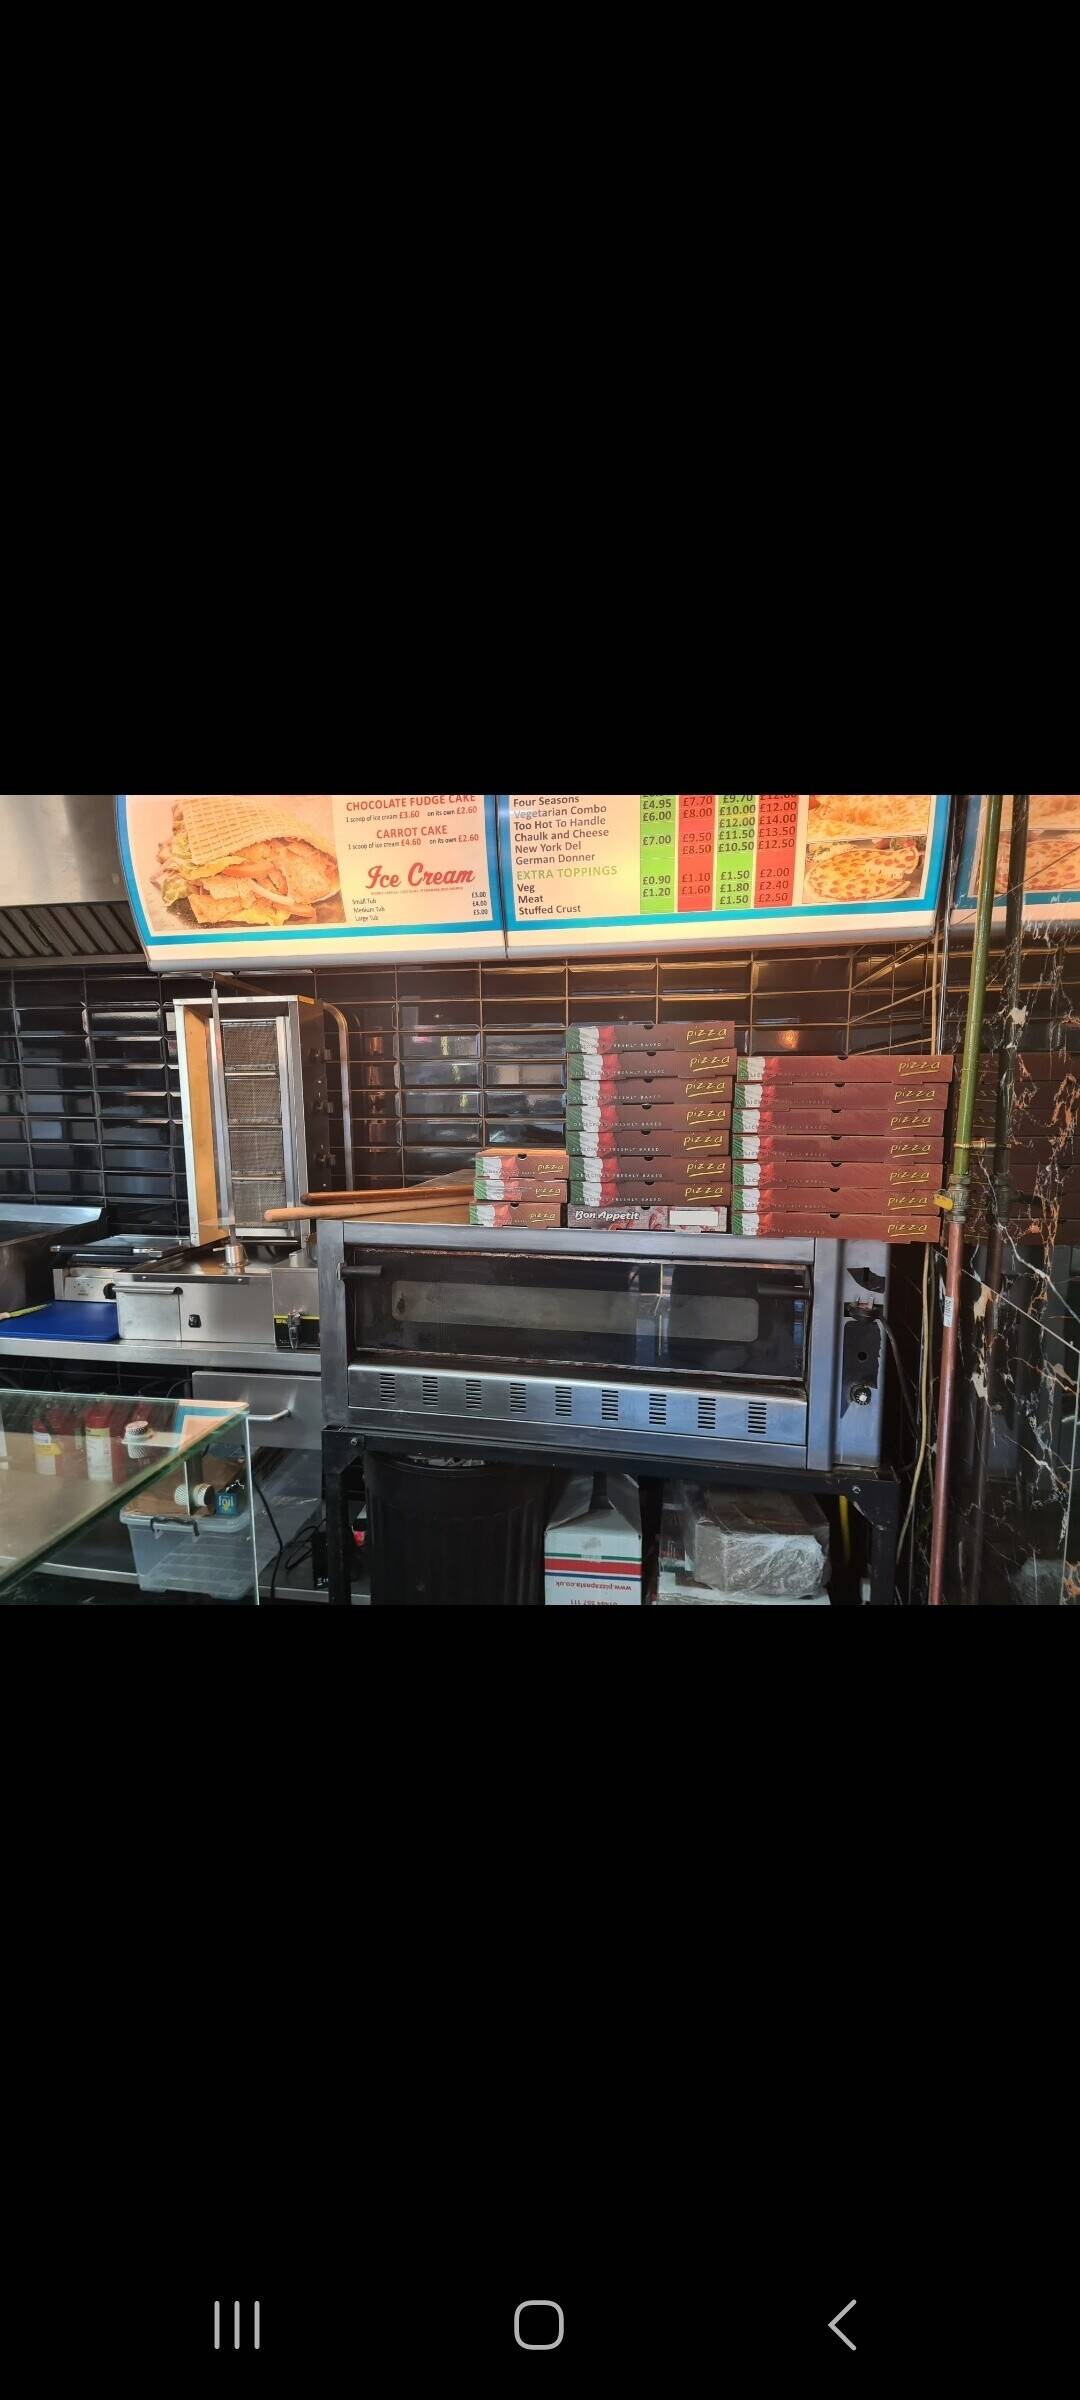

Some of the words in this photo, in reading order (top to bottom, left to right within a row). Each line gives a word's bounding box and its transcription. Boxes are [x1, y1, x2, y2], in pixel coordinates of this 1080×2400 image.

[346, 798, 406, 811] CHOCOLATE
[410, 795, 445, 806] FUDGE
[449, 795, 476, 803] CAKE
[513, 798, 536, 808] Four
[538, 795, 580, 806] Seasons
[513, 807, 568, 820] Vegetarian
[570, 804, 607, 815] Combo
[643, 798, 671, 809] £4.95
[683, 795, 713, 807] £7.70
[723, 795, 753, 803] £9.70
[399, 811, 420, 819] £3.60
[456, 806, 478, 815] £2.60
[514, 821, 532, 830] Too
[534, 820, 553, 830] Hot
[556, 819, 567, 828] To
[570, 816, 606, 827] Handle
[643, 810, 671, 822] £6.00
[683, 808, 713, 819] £8.00
[719, 804, 756, 816] £10.00
[759, 801, 797, 812] £12.00
[376, 827, 417, 839] CARROT
[420, 825, 448, 836] CAKE
[514, 831, 549, 842] Chaulk
[551, 829, 570, 840] and
[573, 828, 609, 838] Cheese
[719, 816, 756, 828] £12.00
[759, 813, 797, 825] £14.00
[352, 843, 368, 851] scoop
[369, 841, 374, 849] of
[401, 838, 422, 847] £4.60
[458, 834, 479, 843] £2.60
[515, 844, 538, 854] New
[540, 842, 562, 853] York
[565, 841, 582, 851] Del
[643, 835, 671, 846] £7.00
[682, 832, 712, 843] £9.50
[718, 828, 755, 840] £11.50
[758, 825, 796, 837] £13.50
[515, 855, 555, 866] German
[558, 853, 595, 863] Donner
[682, 844, 712, 855] £8.50
[718, 841, 755, 853] £10.50
[758, 838, 795, 850] £12.50
[365, 865, 402, 889] Ice
[407, 862, 476, 887] Cream
[517, 869, 554, 881] EXTRA
[557, 865, 618, 878] TOPPINGS
[517, 883, 535, 893] Veg
[642, 875, 671, 885] £0.90
[682, 872, 711, 883] £1.10
[720, 870, 750, 880] £1.50
[759, 867, 790, 878] £2.00
[471, 891, 487, 899] £3.00
[518, 895, 544, 904] Meat
[642, 887, 671, 897] £1.20
[682, 885, 710, 895] £1.60
[719, 882, 750, 893] £1.80
[759, 880, 789, 891] £2.40
[353, 906, 374, 914] Medium
[518, 905, 554, 916] Stuffed
[556, 904, 582, 914] Crust
[719, 894, 749, 905] £1.50
[758, 892, 788, 903] £2.50
[355, 914, 369, 922] Large
[473, 908, 488, 916] £5.00
[686, 1025, 727, 1041] pizza
[690, 1053, 730, 1068] pizza
[898, 1059, 940, 1072] pizza
[685, 1080, 725, 1094] pizza
[894, 1088, 935, 1100] pizza
[686, 1106, 726, 1121] pizza
[890, 1113, 932, 1126] pizza
[683, 1132, 723, 1146] pizza
[890, 1140, 932, 1153] pizza
[537, 1162, 564, 1171] pizza
[687, 1160, 726, 1173] pizza
[889, 1168, 930, 1181] pizza
[684, 1184, 723, 1197] pizza
[887, 1194, 928, 1206] pizza
[575, 1210, 596, 1221] Bon
[598, 1210, 640, 1223] Appetit
[887, 1221, 928, 1233] pizza
